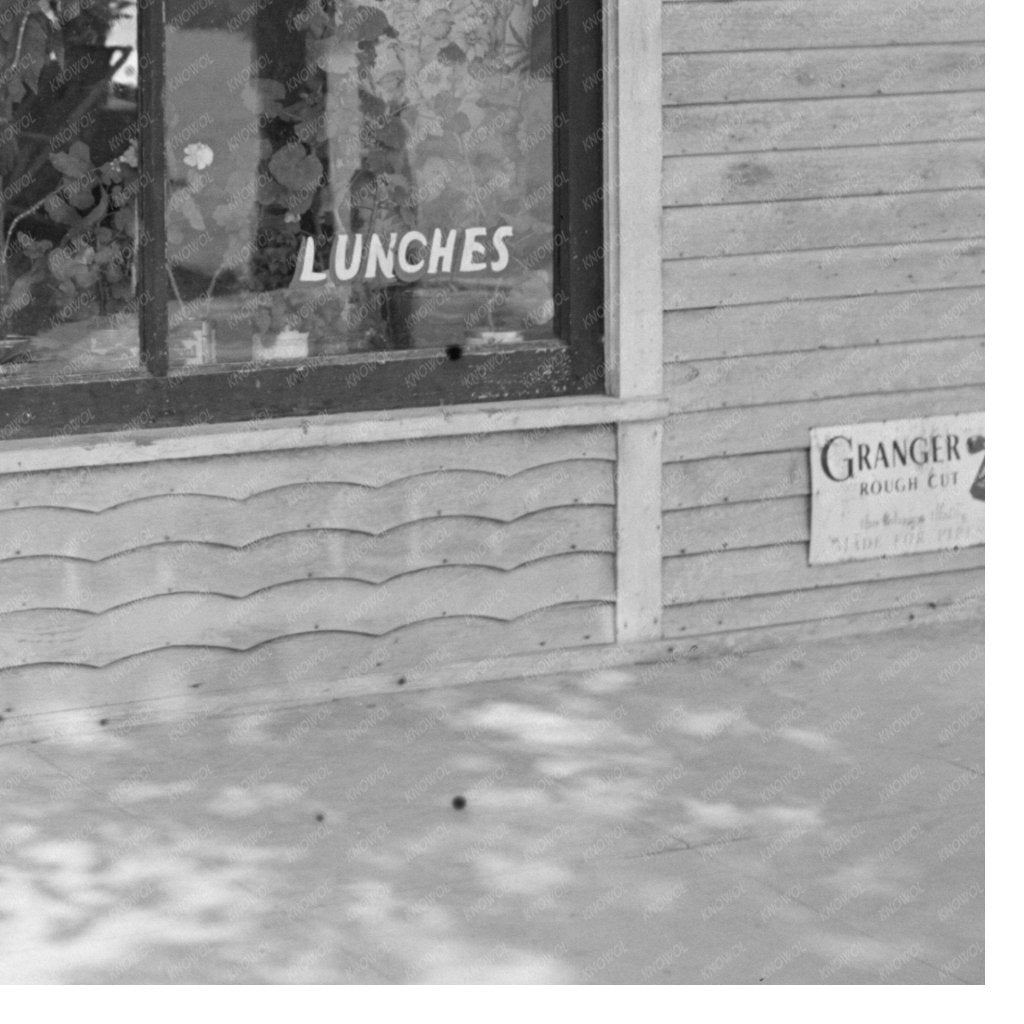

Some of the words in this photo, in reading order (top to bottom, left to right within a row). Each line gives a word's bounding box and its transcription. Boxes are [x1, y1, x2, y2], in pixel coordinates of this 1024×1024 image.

[298, 225, 514, 282] LUNCHES
[821, 434, 961, 482] GRANGER
[860, 476, 918, 496] ROUGH
[928, 471, 960, 489] CUT
